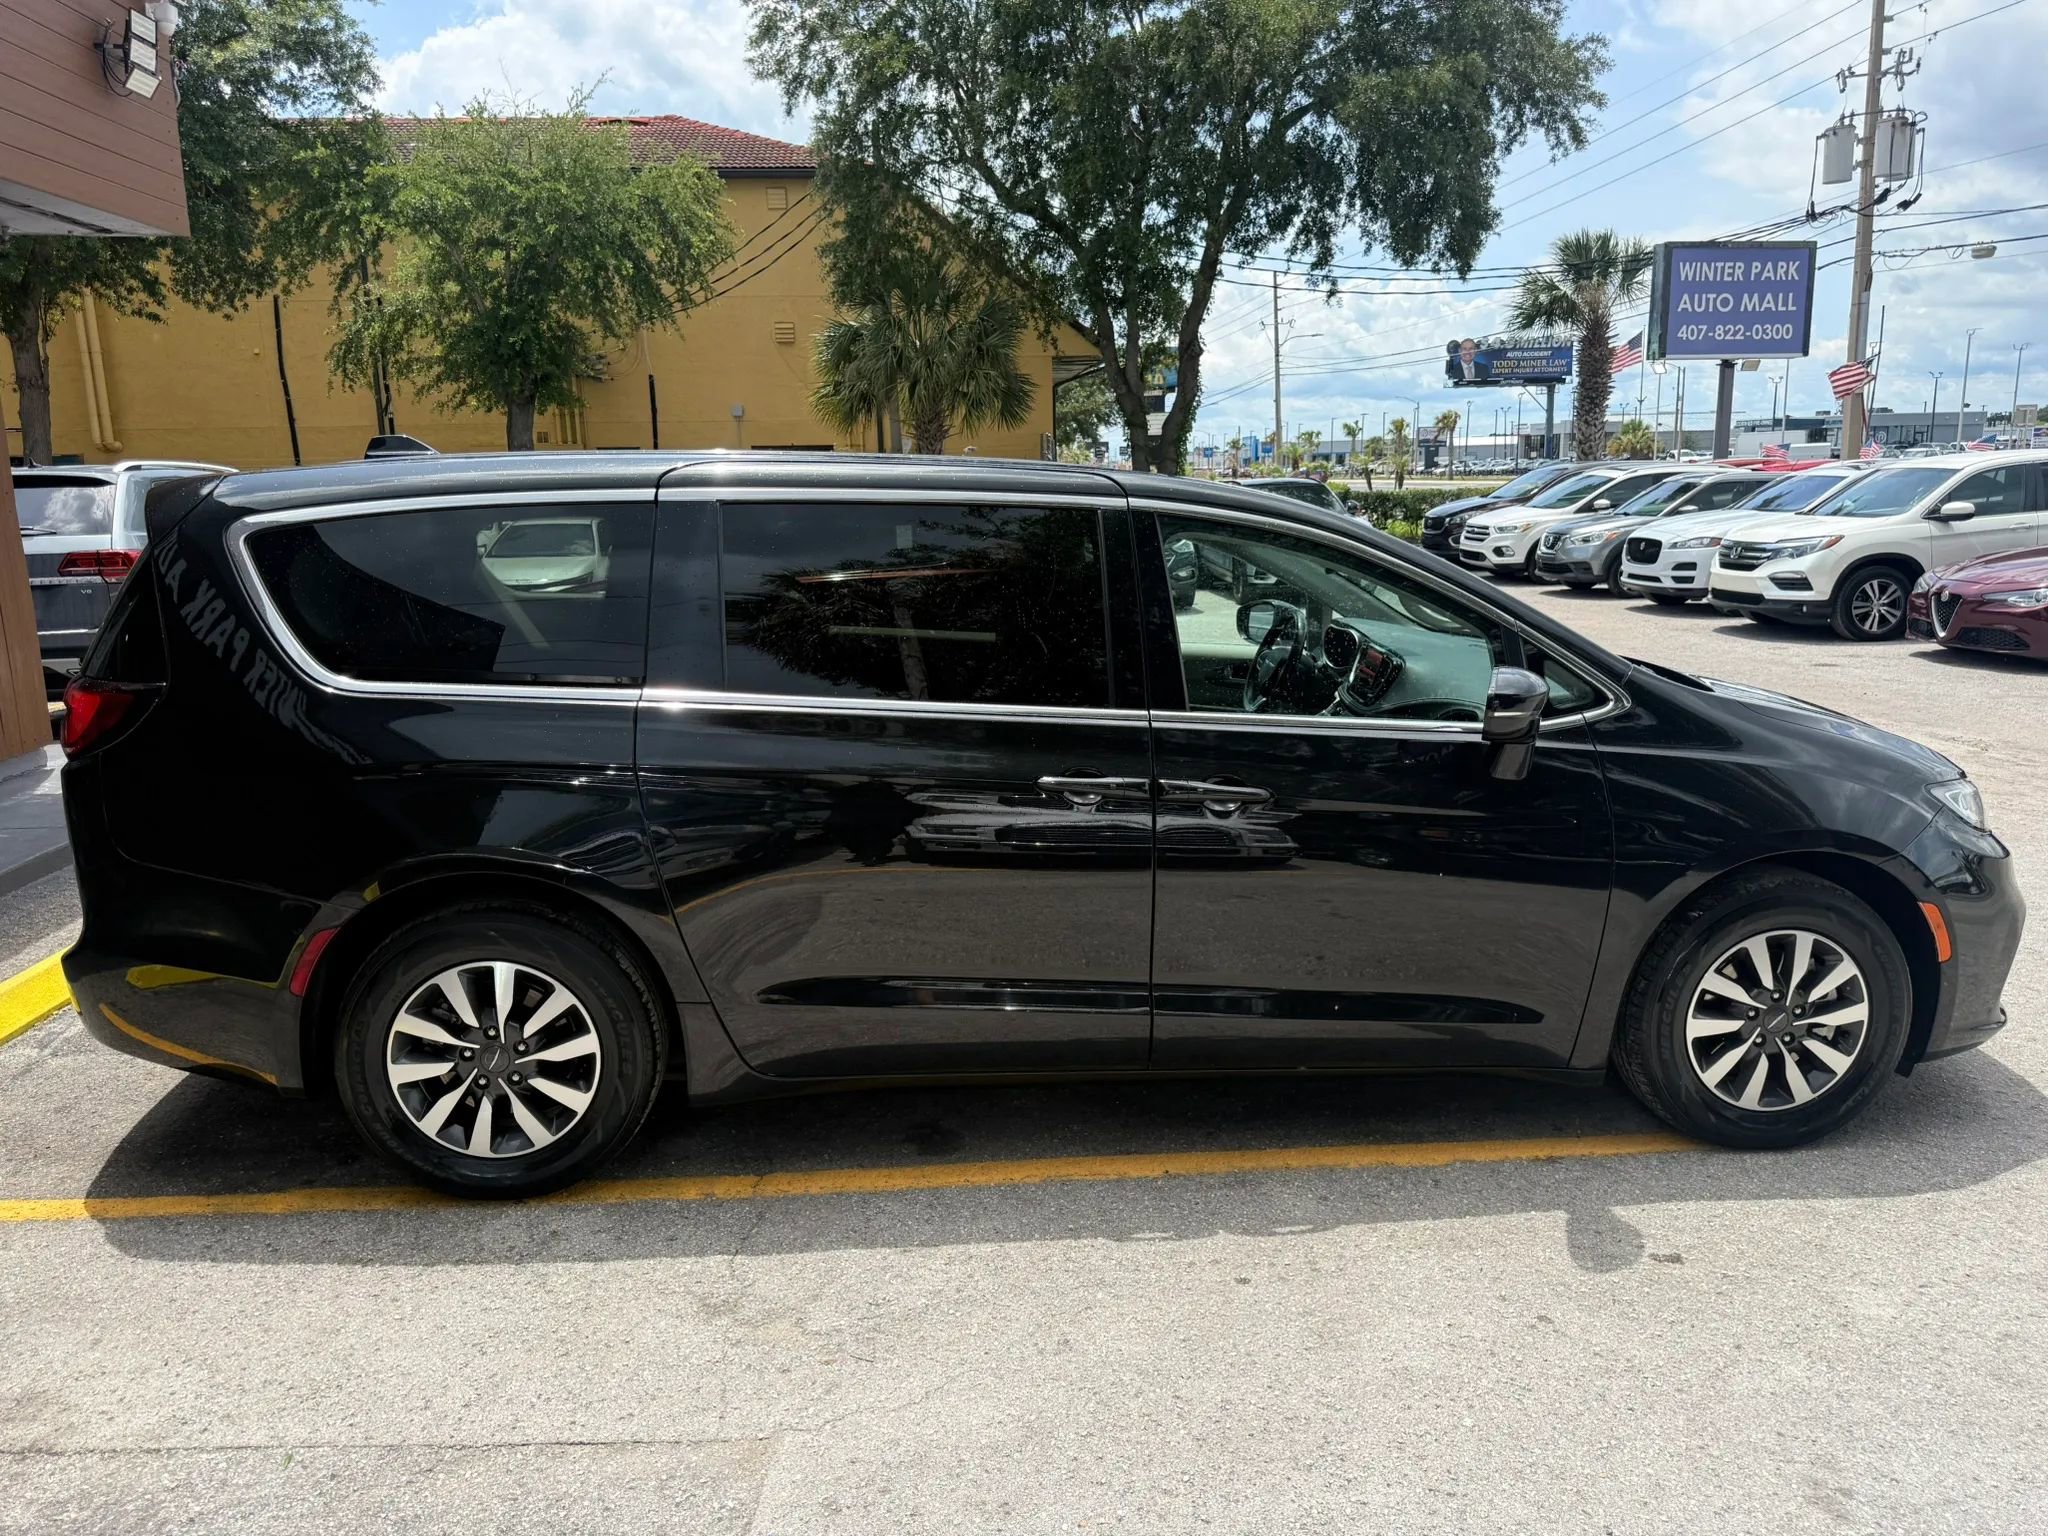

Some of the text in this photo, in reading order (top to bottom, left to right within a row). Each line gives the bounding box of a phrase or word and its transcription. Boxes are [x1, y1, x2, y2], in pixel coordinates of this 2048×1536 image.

[1679, 261, 1801, 281] WINTER PARK
[1677, 293, 1797, 312] AUTO MALL
[1677, 324, 1793, 341] 407-822-0300
[1492, 358, 1568, 368] TODD MINER LAW
